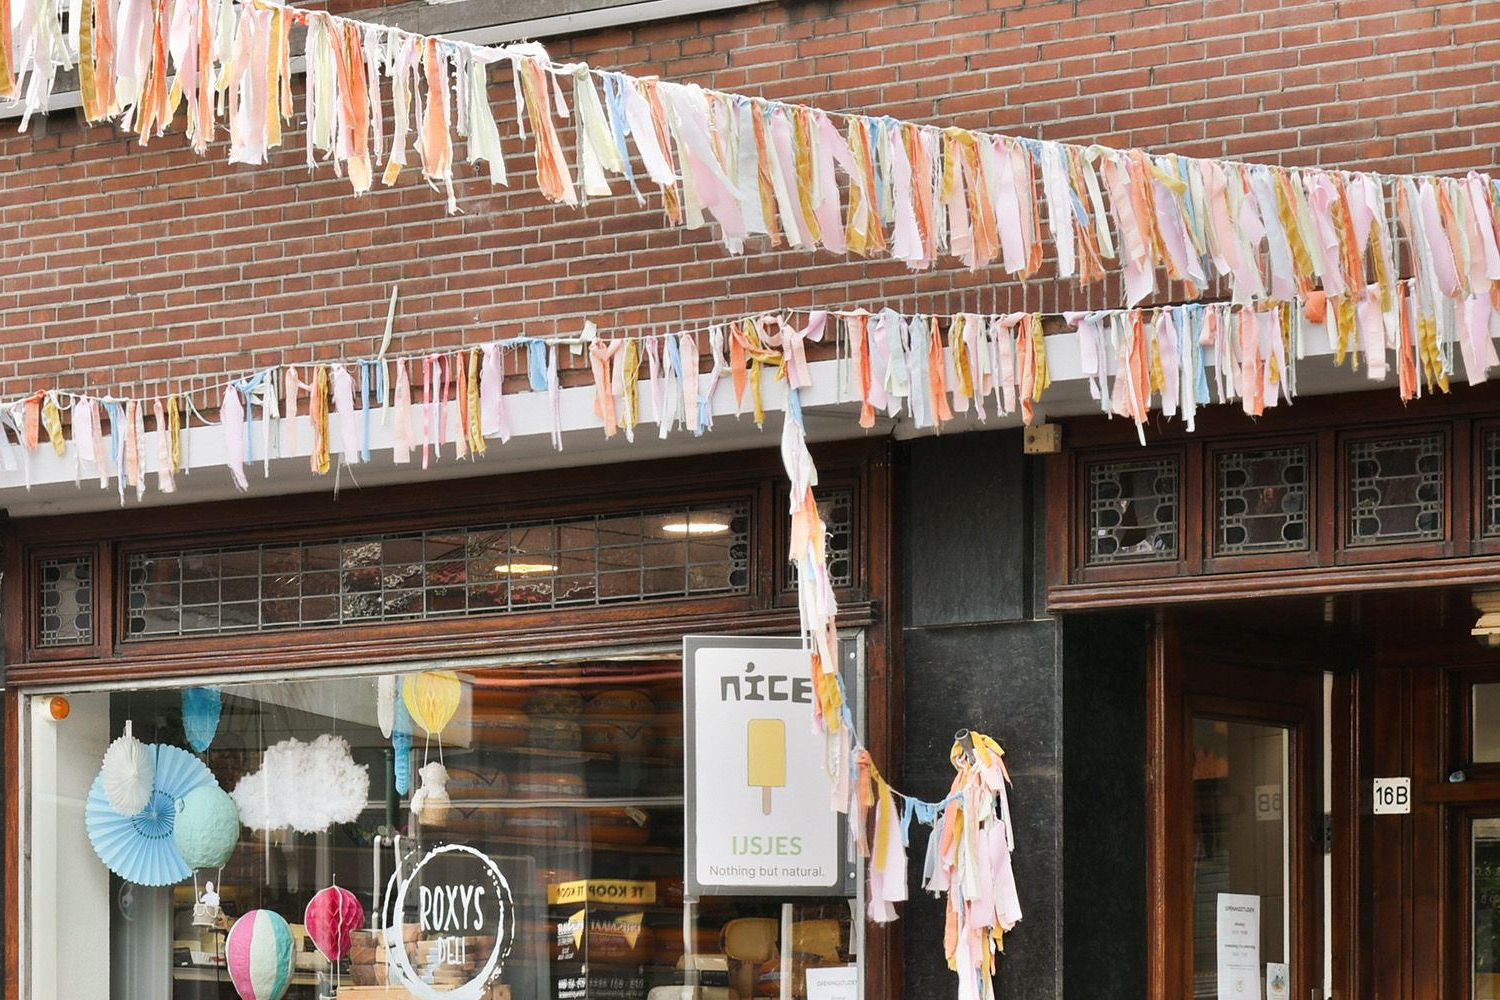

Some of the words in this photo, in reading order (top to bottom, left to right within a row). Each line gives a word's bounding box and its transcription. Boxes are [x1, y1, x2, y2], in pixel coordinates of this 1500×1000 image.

[1376, 786, 1408, 805] 16B
[732, 836, 803, 856] IJSJES
[709, 866, 756, 879] Nothing
[759, 866, 779, 877] but
[782, 866, 825, 878] natural.
[419, 884, 486, 932] ROXYS
[437, 936, 466, 965] DELI
